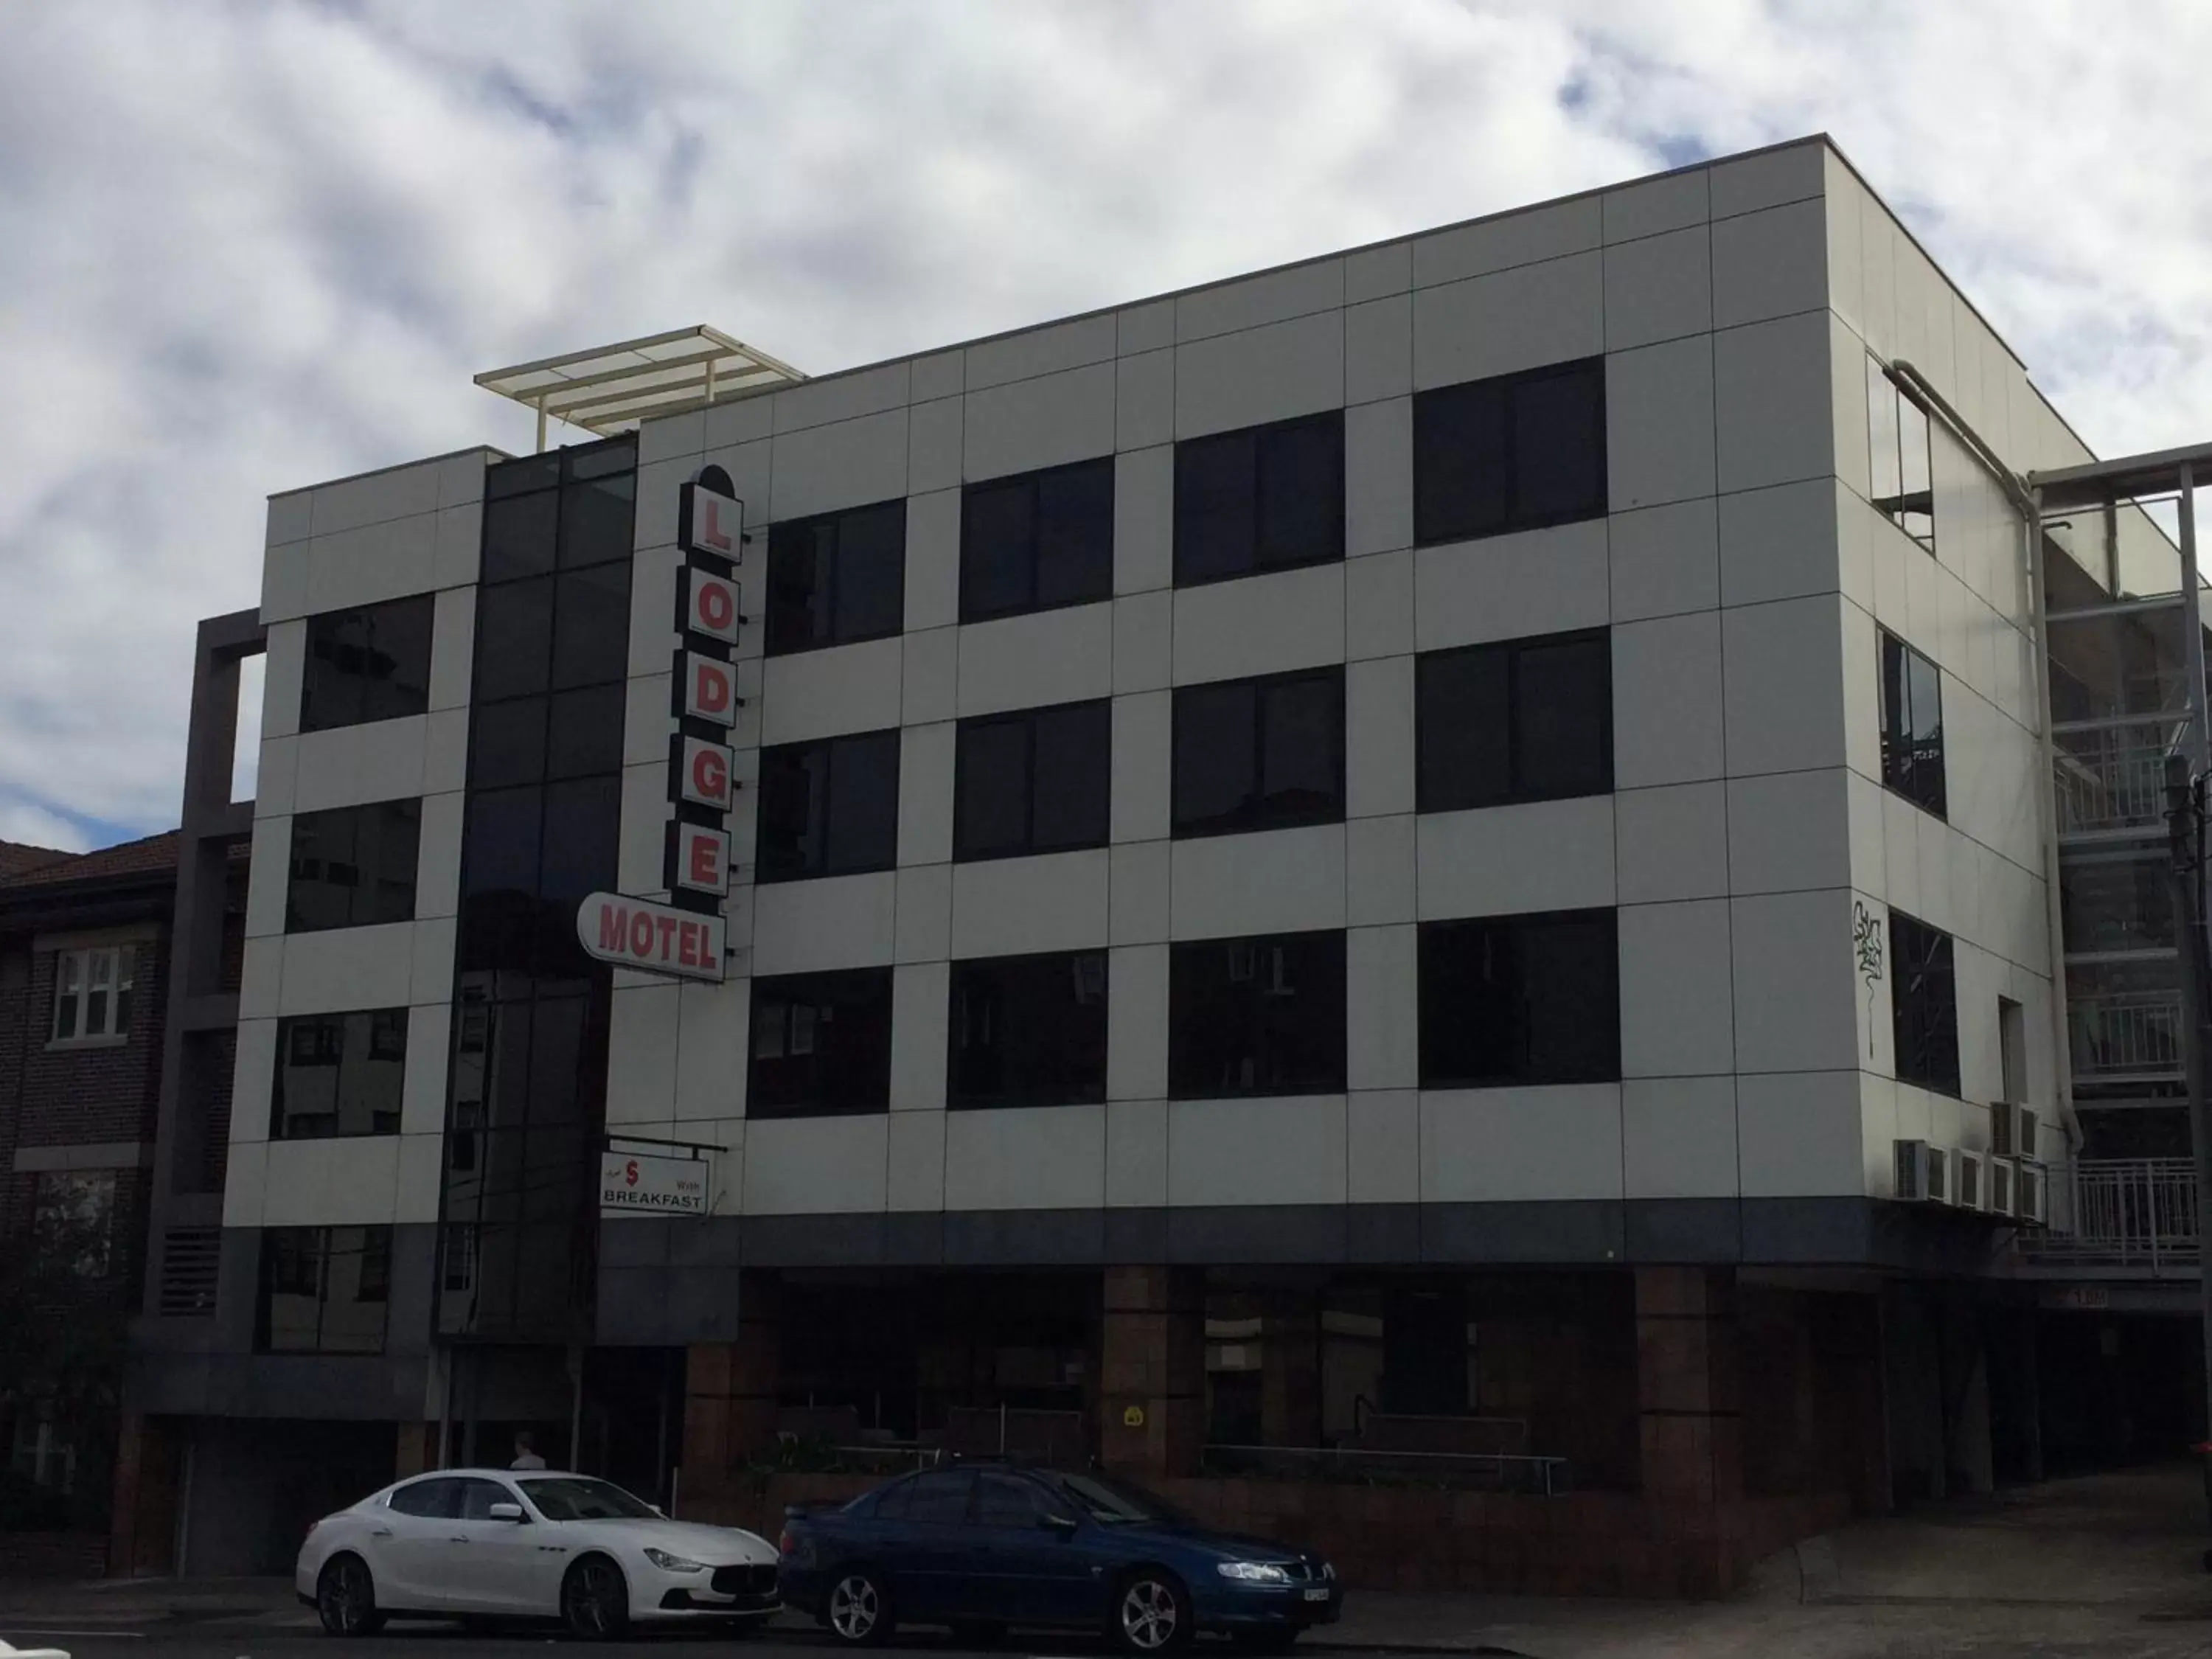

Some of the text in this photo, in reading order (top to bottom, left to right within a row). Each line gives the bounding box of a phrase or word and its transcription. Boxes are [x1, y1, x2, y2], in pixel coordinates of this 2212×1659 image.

[690, 500, 732, 883] LODGE
[599, 903, 716, 969] MOTEL
[603, 1189, 703, 1208] BREAKFAST
